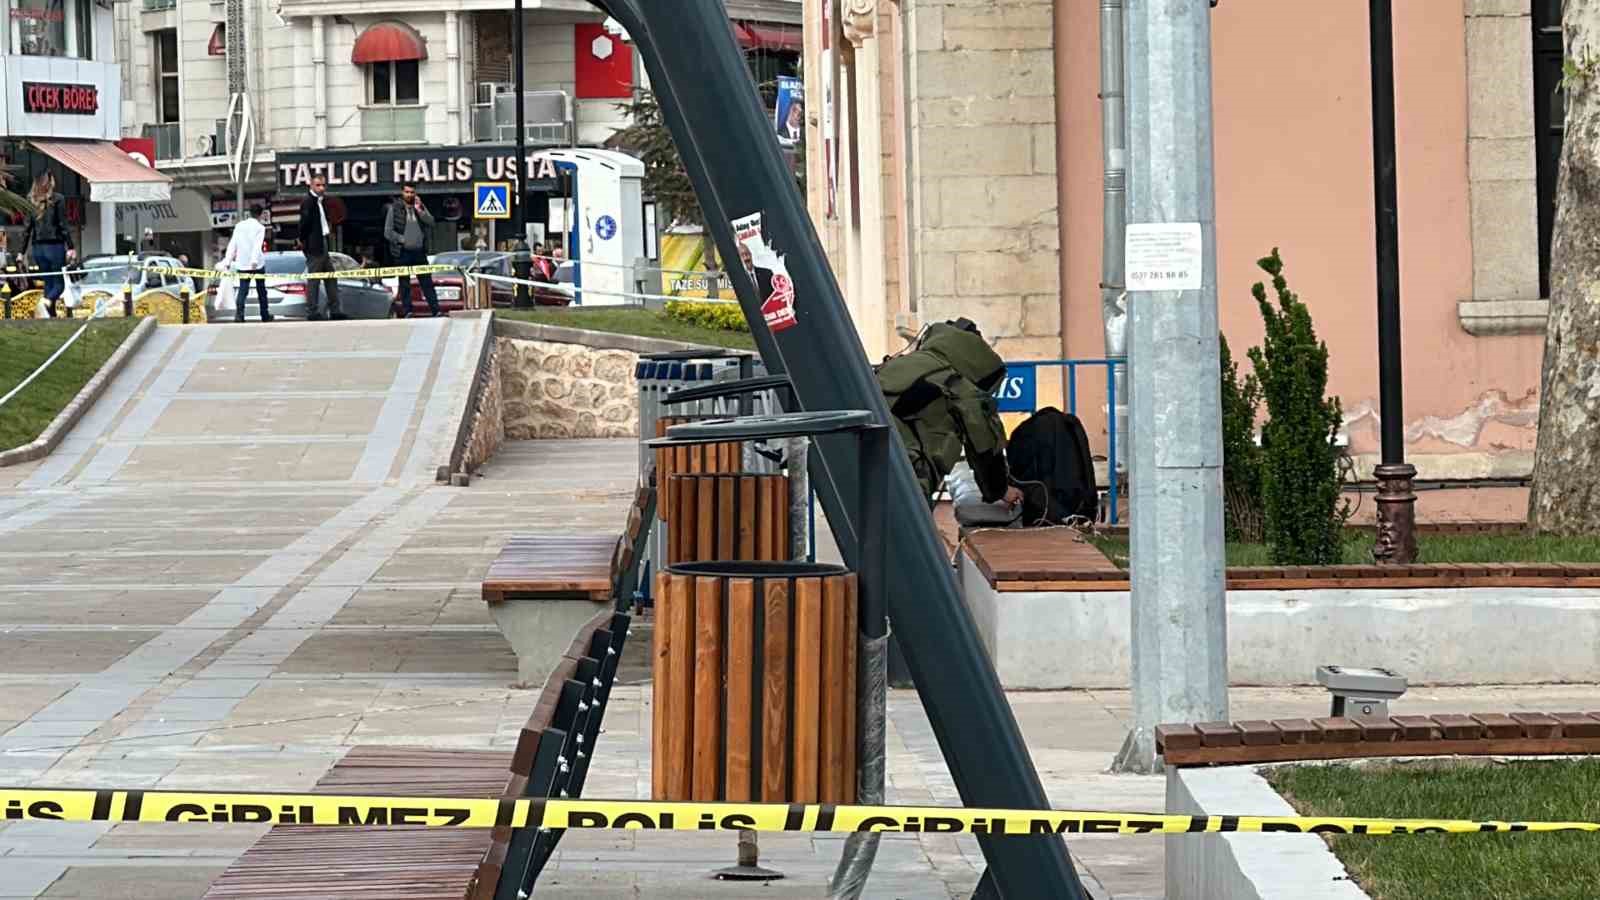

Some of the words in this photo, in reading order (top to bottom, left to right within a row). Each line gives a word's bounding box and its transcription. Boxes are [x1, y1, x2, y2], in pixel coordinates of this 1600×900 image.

[280, 160, 377, 187] TATLICI
[486, 155, 557, 180] USTA
[671, 279, 693, 291] TAZE
